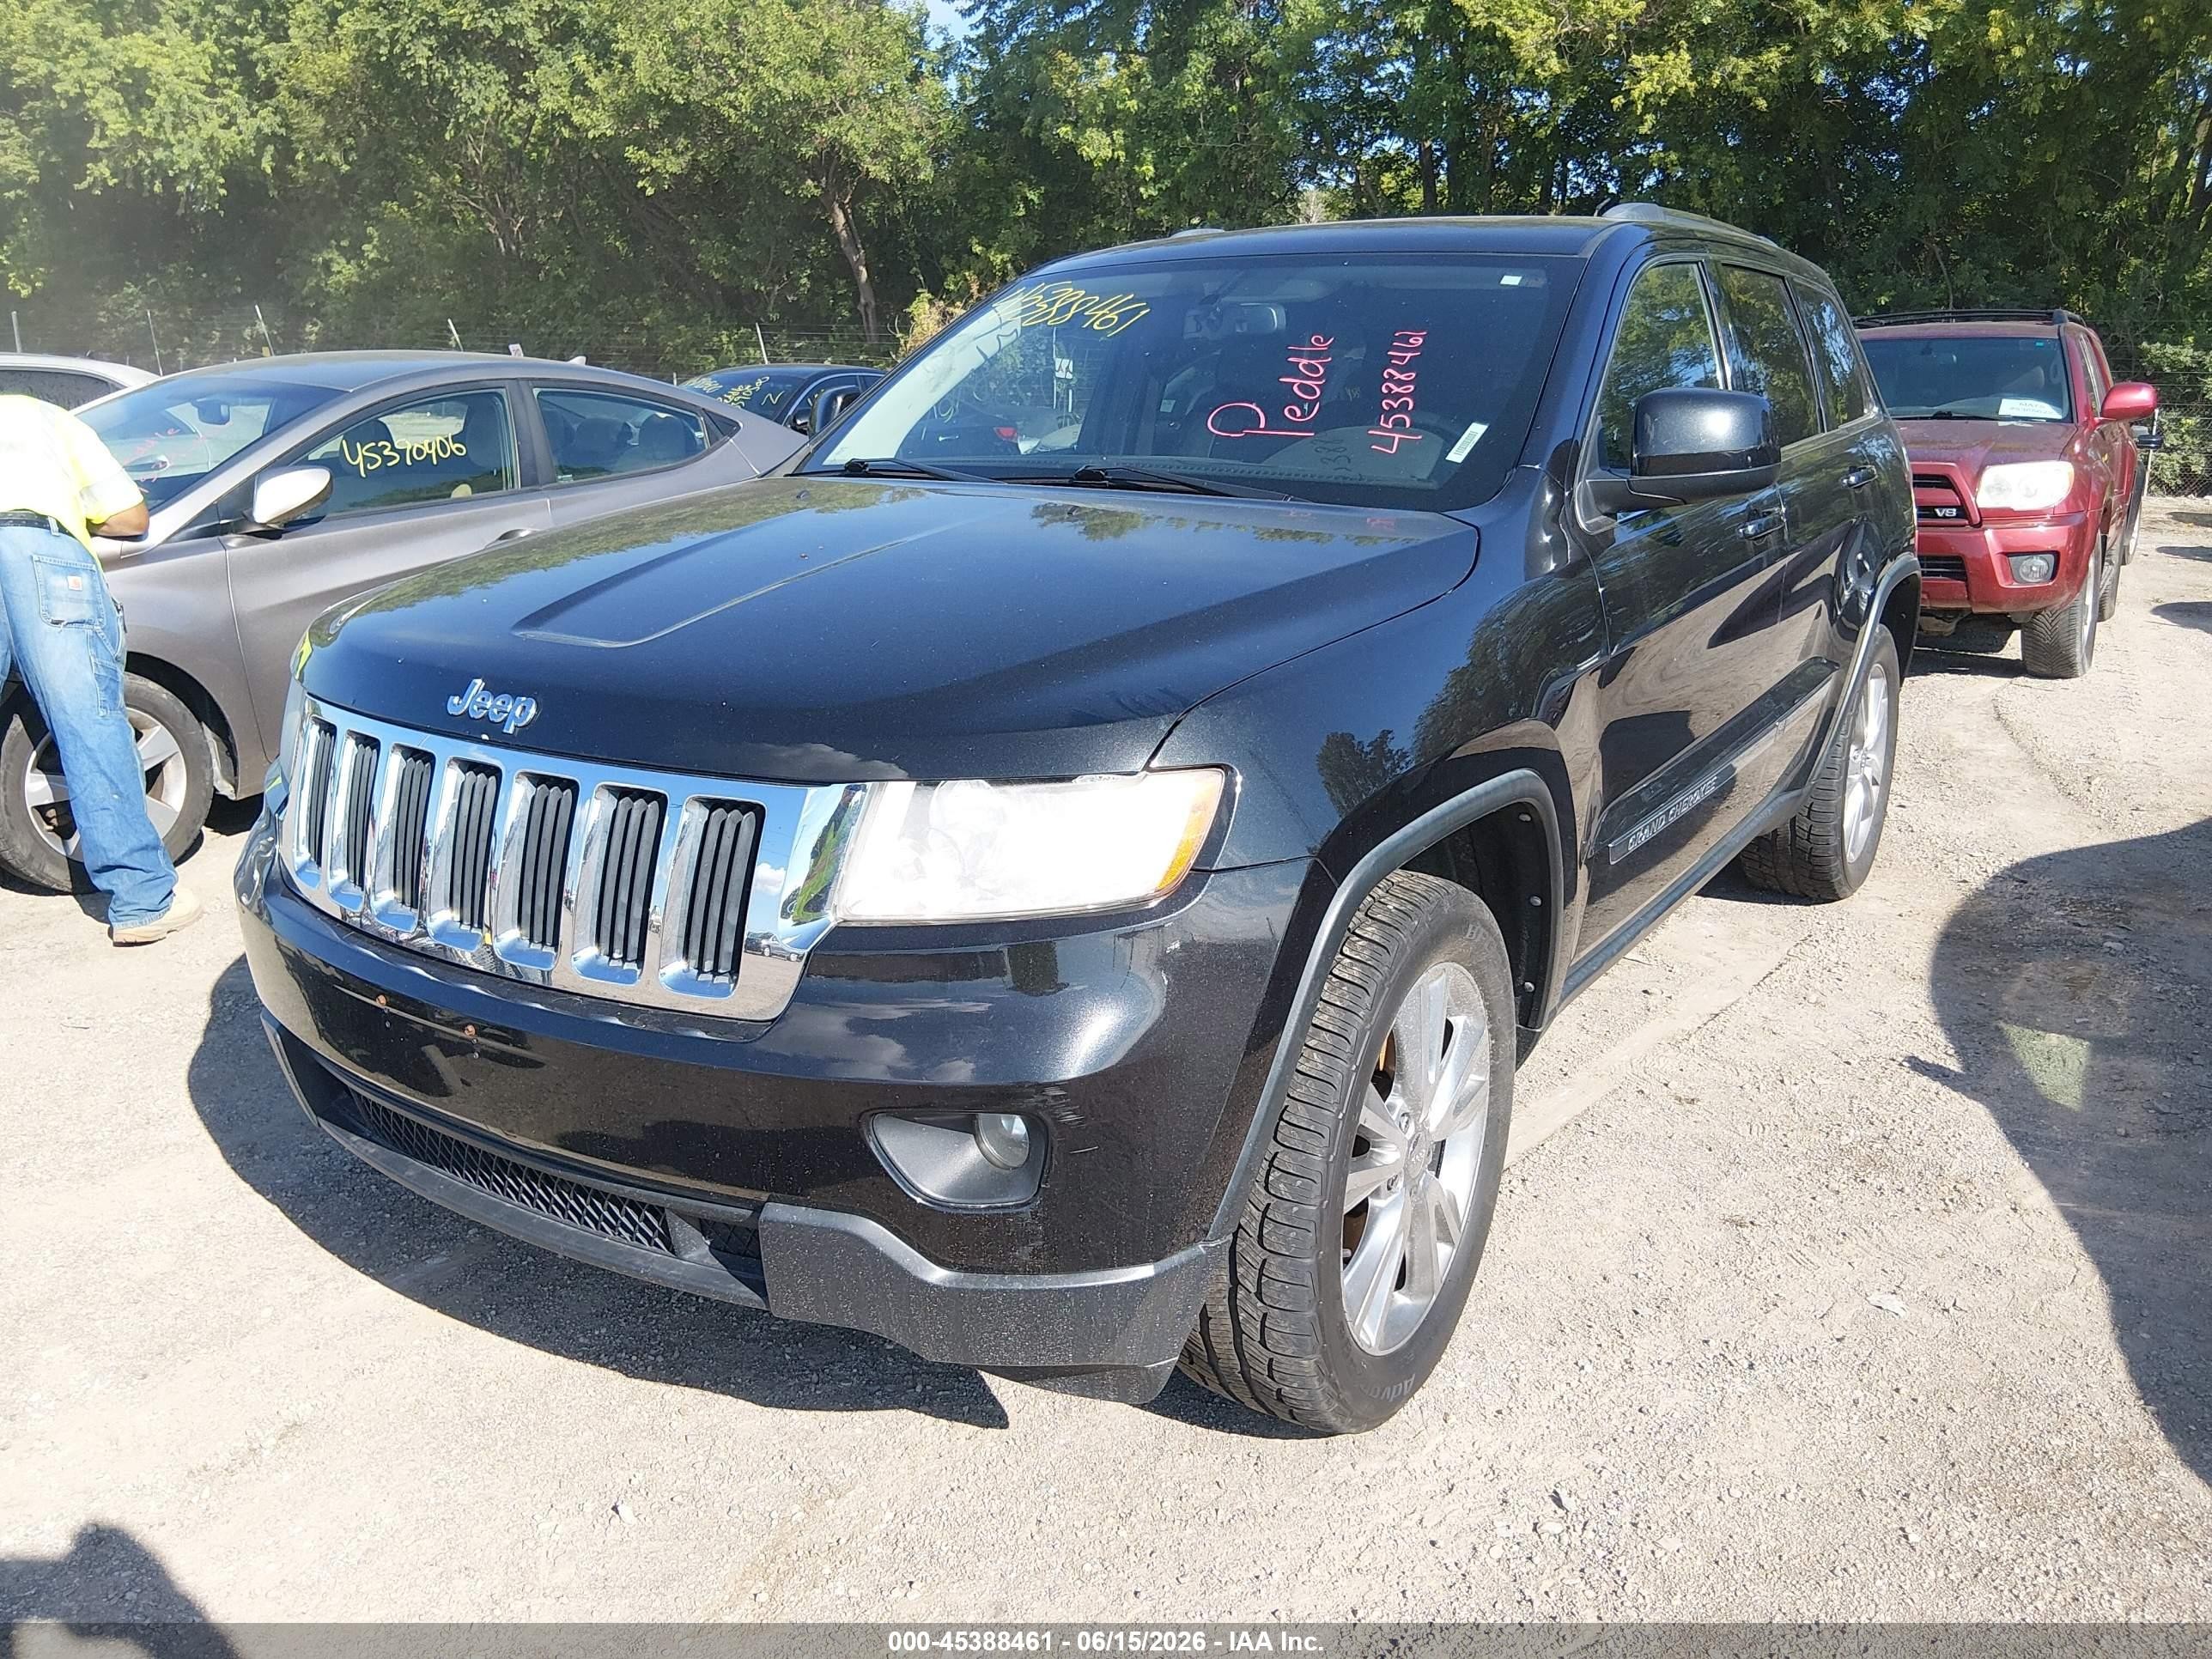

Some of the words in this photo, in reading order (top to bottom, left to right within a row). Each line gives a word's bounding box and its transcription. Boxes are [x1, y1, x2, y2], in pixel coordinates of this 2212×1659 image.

[1206, 334, 1334, 437] Peddle
[1367, 330, 1428, 454] 45388461
[342, 433, 467, 478] 45390406
[1934, 507, 1957, 517] V8
[447, 678, 538, 734] Jeep
[1627, 814, 1667, 851] GRAND
[1668, 775, 1718, 822] CHEROKEE
